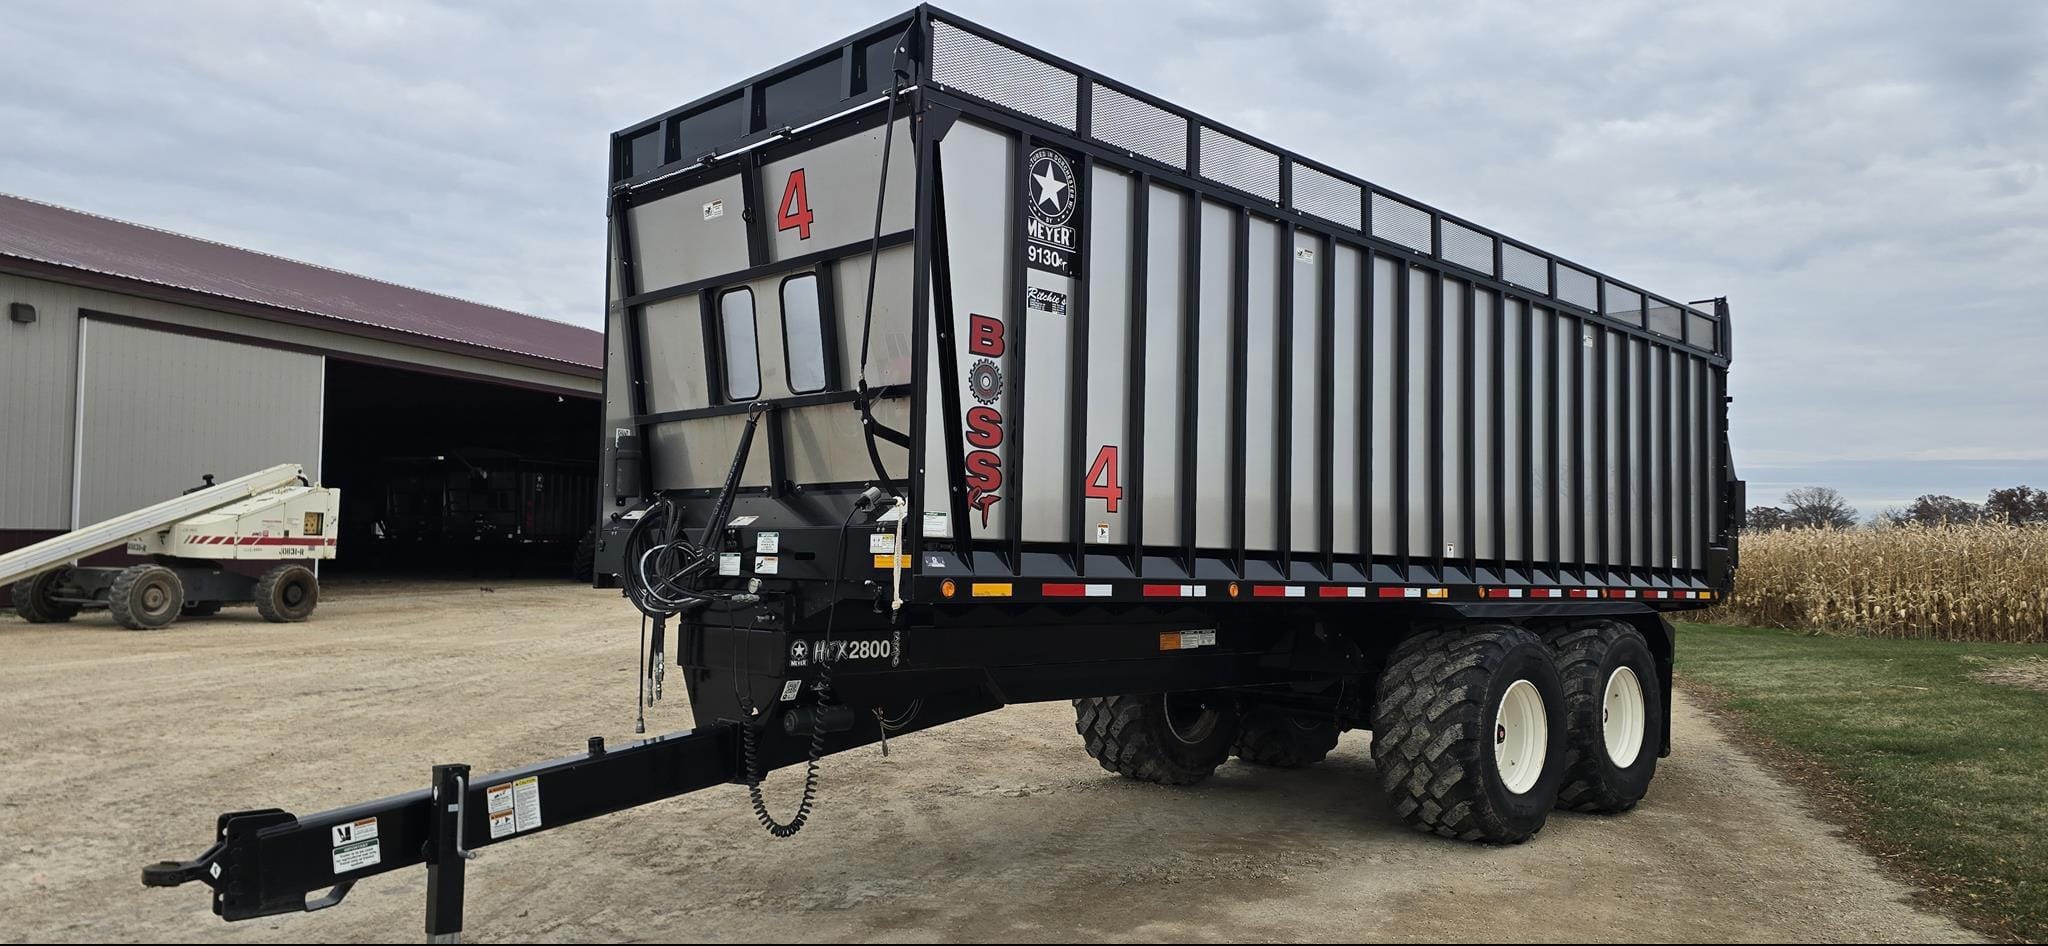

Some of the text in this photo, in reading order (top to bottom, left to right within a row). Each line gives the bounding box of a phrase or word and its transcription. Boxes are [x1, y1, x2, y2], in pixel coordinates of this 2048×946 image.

[778, 168, 813, 240] 4
[1028, 218, 1070, 246] MEYER
[1028, 287, 1066, 306] Ritchie's
[1085, 445, 1123, 513] 4
